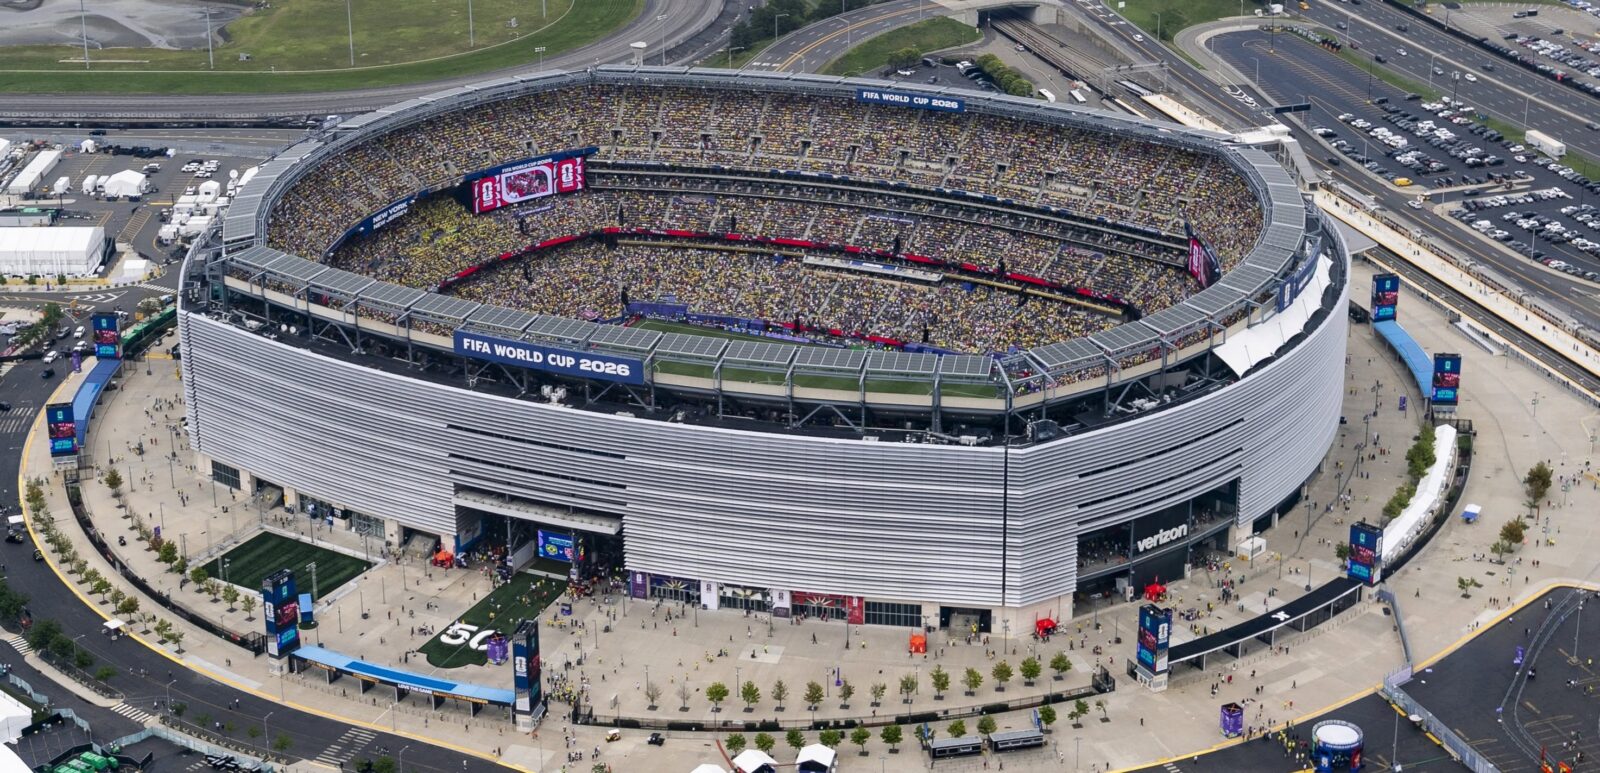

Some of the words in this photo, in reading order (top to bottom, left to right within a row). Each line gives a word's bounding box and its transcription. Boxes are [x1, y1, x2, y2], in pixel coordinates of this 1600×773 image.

[882, 94, 909, 103] WORLD
[932, 99, 958, 108] 2026
[373, 211, 388, 223] NEW
[389, 201, 407, 214] YORK
[373, 219, 386, 230] NEW
[386, 208, 408, 222] JERSEY
[463, 338, 491, 354] FIFA
[494, 343, 543, 363] WORLD
[548, 353, 575, 368] CUP
[579, 359, 630, 377] 2026
[1137, 524, 1188, 552] verizon
